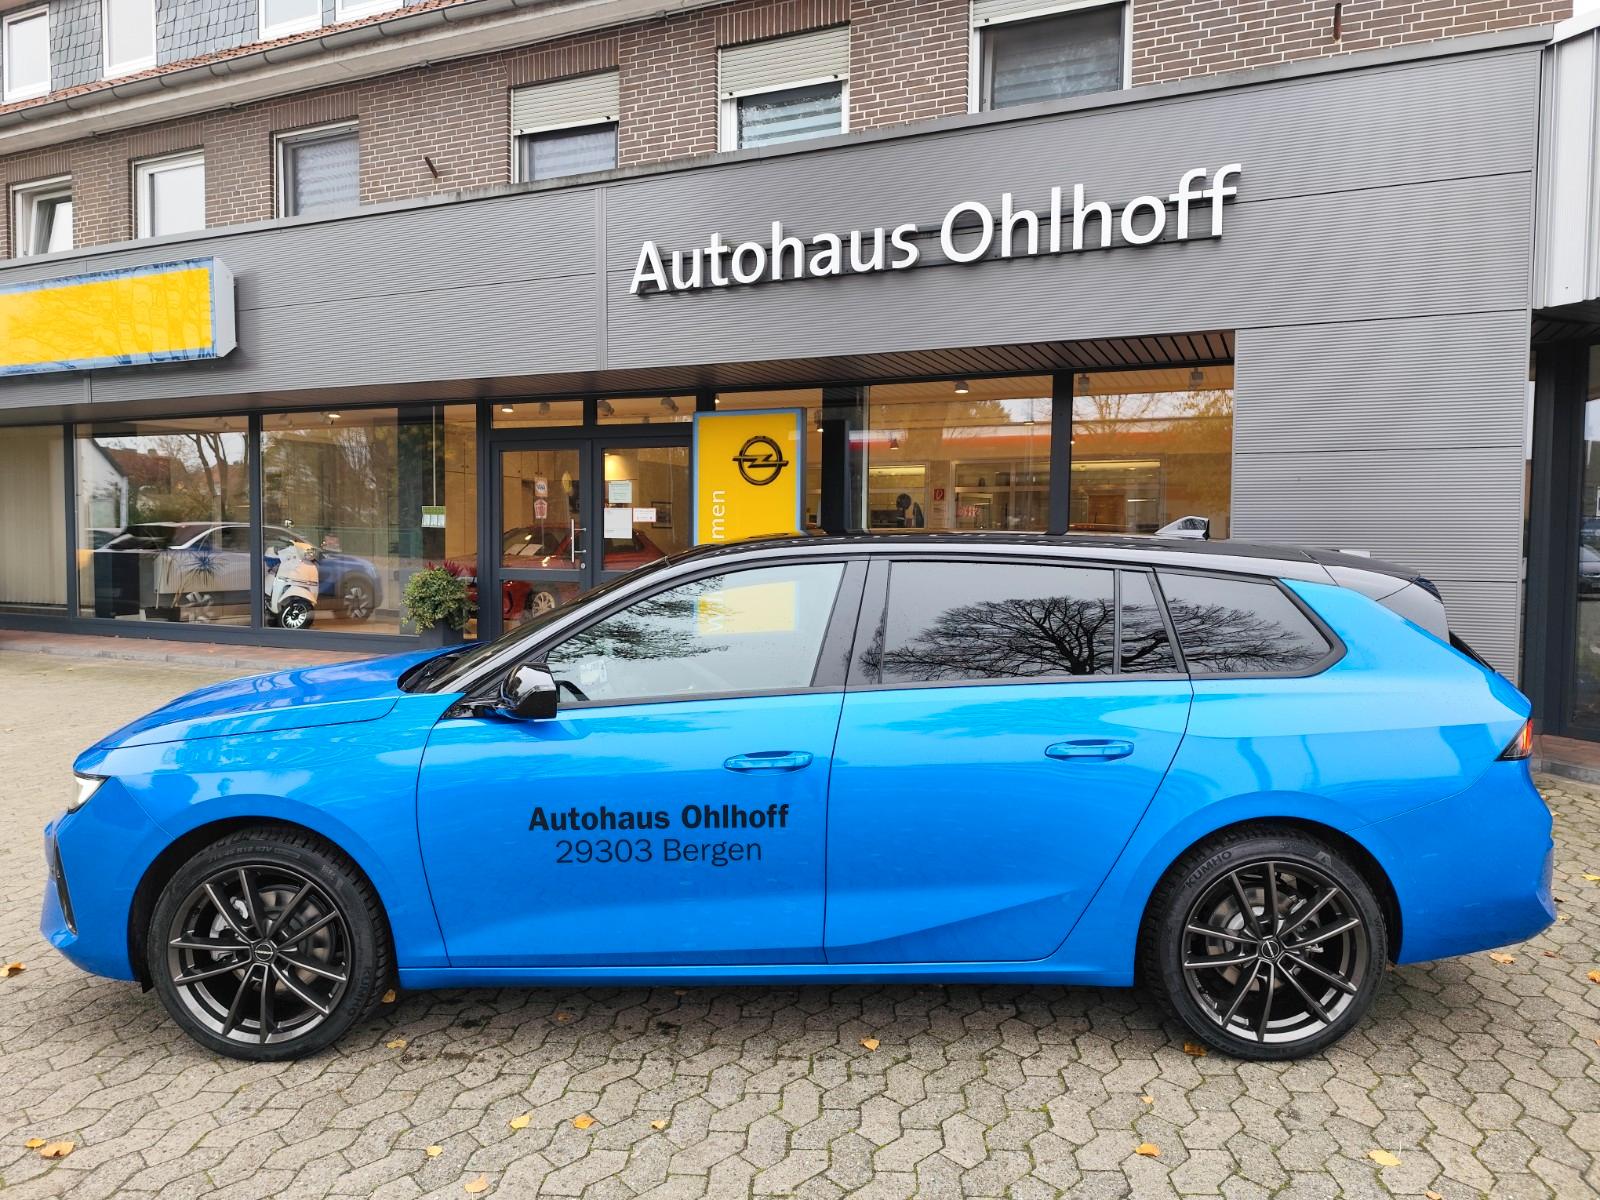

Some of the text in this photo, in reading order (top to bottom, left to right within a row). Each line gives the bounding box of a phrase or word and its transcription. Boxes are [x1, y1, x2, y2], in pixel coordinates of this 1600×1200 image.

[627, 162, 1244, 295] Autohaus Ohlhoff
[711, 489, 727, 540] men
[528, 803, 790, 832] Autohaus Ohlhoff
[555, 838, 762, 868] 29303 Bergen
[1185, 850, 1233, 889] KUMHO
